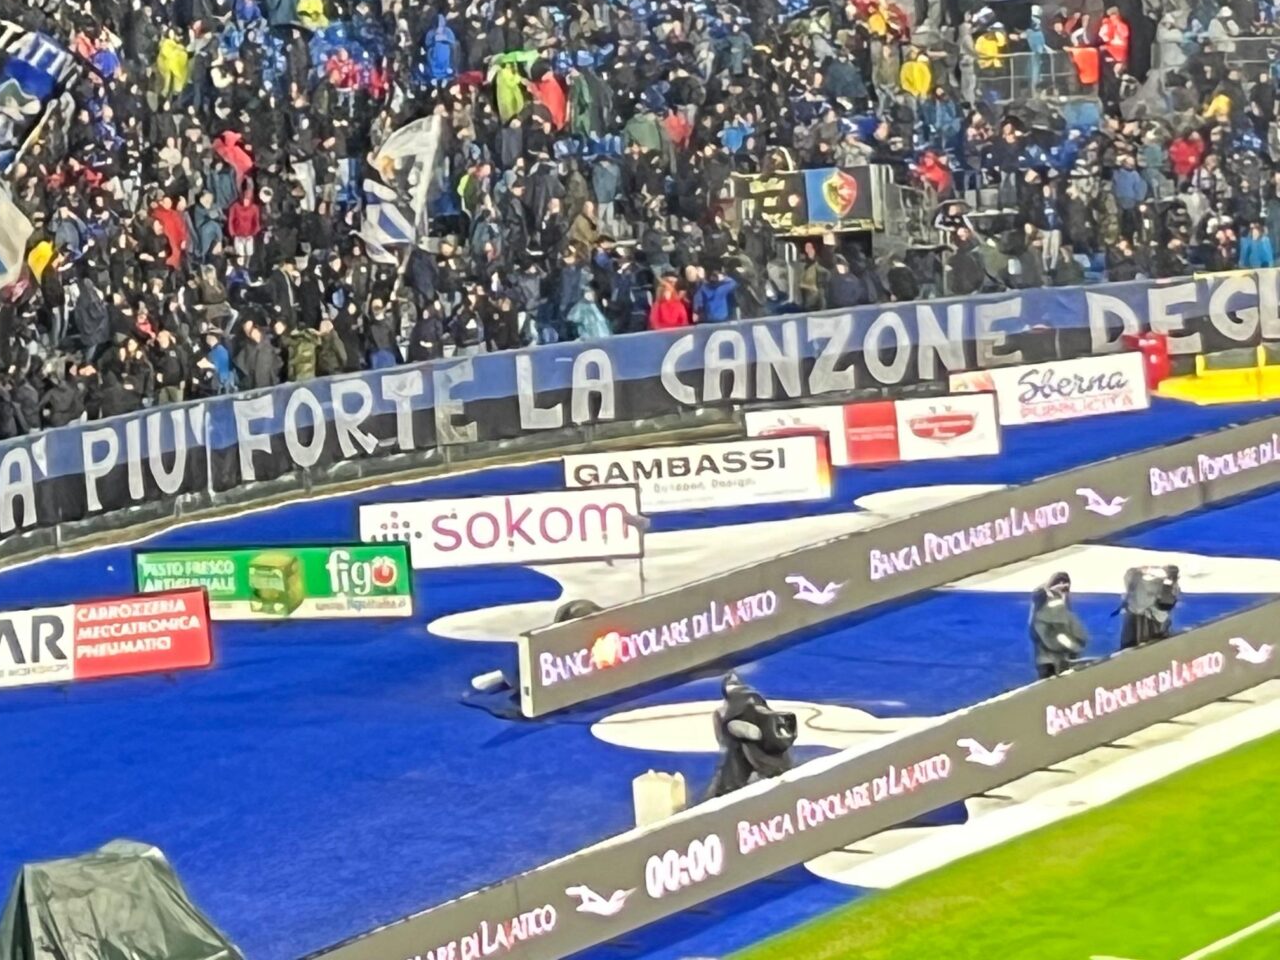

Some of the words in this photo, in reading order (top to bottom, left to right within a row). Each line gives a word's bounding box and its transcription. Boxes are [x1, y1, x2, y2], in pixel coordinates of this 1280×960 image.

[233, 357, 478, 482] FORTE
[515, 348, 616, 430] LA
[661, 298, 1023, 405] CANZONE
[573, 447, 786, 486] GAMBASSI
[430, 496, 631, 553] sokom
[869, 545, 922, 581] BANCA
[923, 521, 995, 564] POPOLARE
[995, 517, 1012, 541] DI
[76, 598, 187, 623] CARROZZERIA
[76, 615, 201, 640] MECCATRONICA
[692, 613, 709, 640] DI
[76, 635, 172, 659] PNEUMATICI
[1046, 699, 1094, 736] BANCA
[736, 813, 795, 855] BANCA
[796, 781, 872, 831] POPOLARE
[871, 777, 889, 802] DI
[645, 833, 724, 900] 00:00
